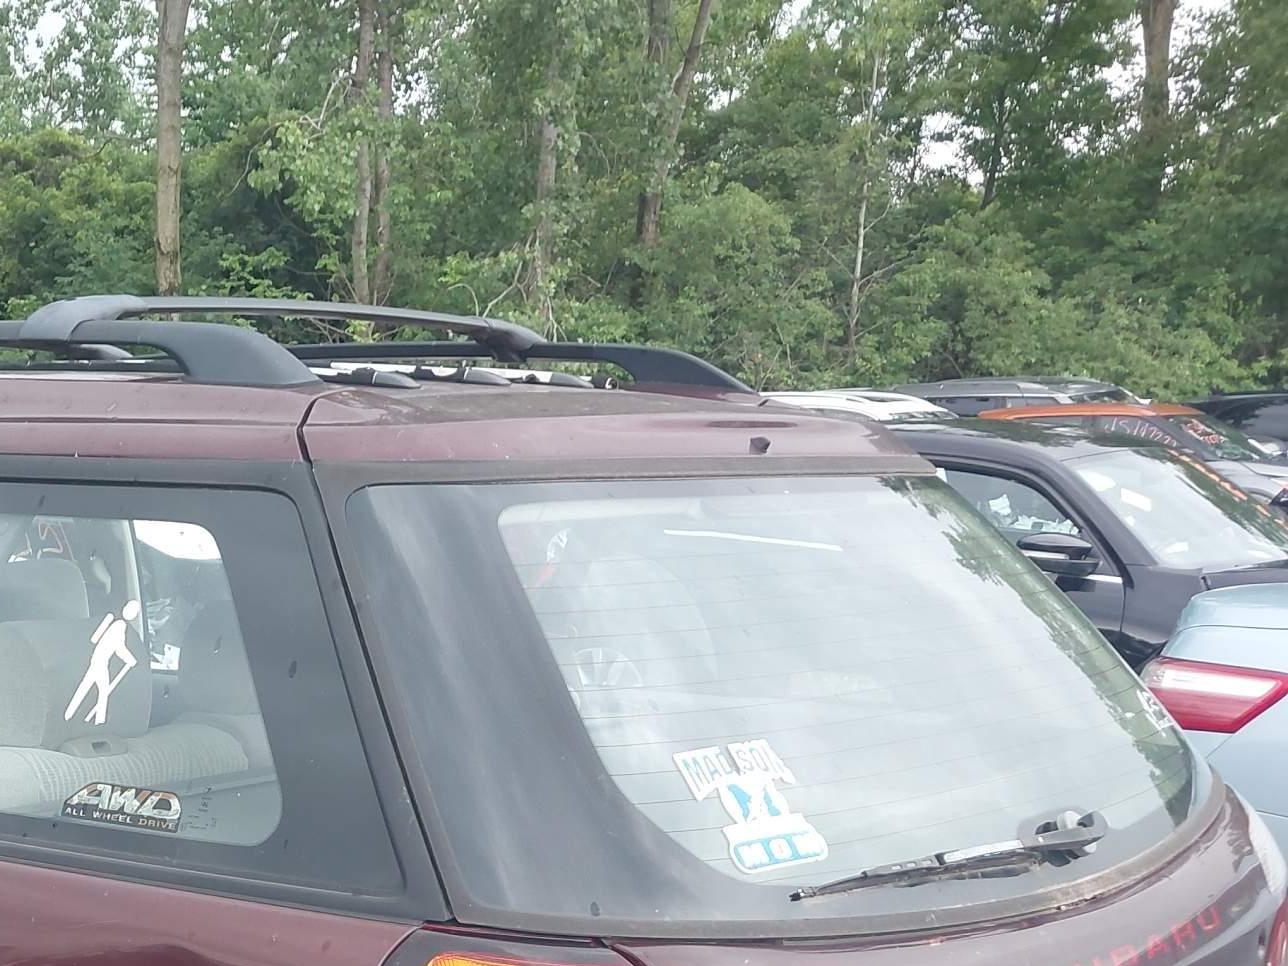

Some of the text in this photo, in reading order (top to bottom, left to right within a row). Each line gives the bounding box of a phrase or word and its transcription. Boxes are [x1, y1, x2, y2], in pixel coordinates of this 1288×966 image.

[69, 783, 181, 820] AWD
[64, 807, 177, 830] ALL WHEEL DRIVE
